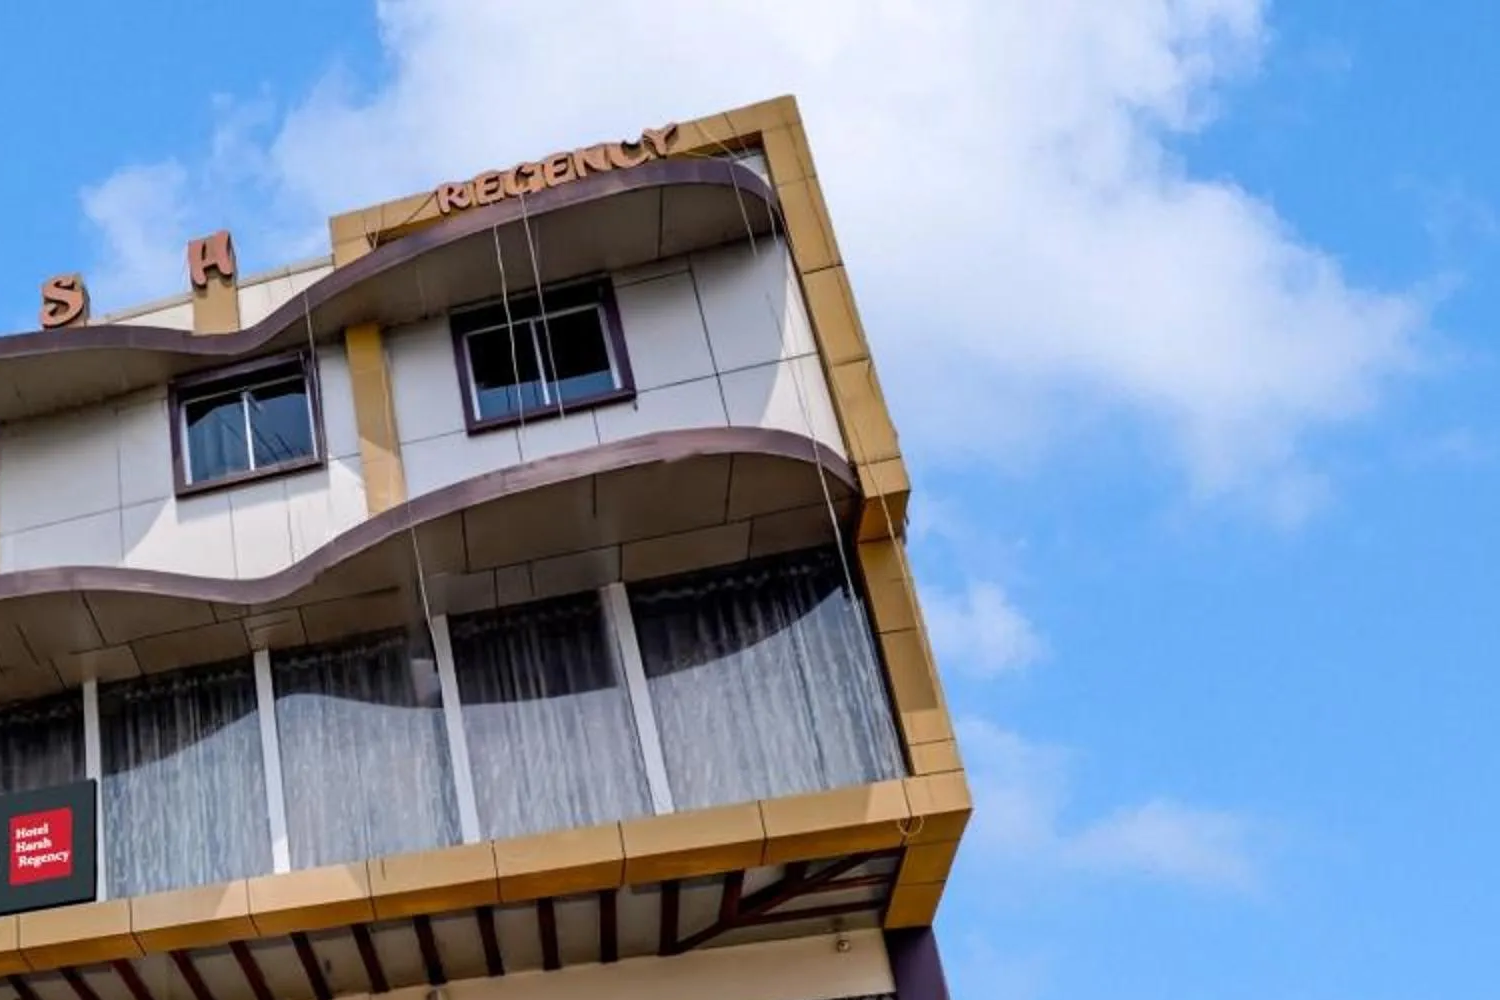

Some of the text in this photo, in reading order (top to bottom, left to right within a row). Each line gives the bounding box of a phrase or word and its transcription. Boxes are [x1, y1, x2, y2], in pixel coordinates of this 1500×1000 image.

[436, 123, 678, 214] REGENCY
[15, 823, 49, 840] Hotel
[15, 838, 52, 853] Harsh
[18, 851, 70, 868] Regency
